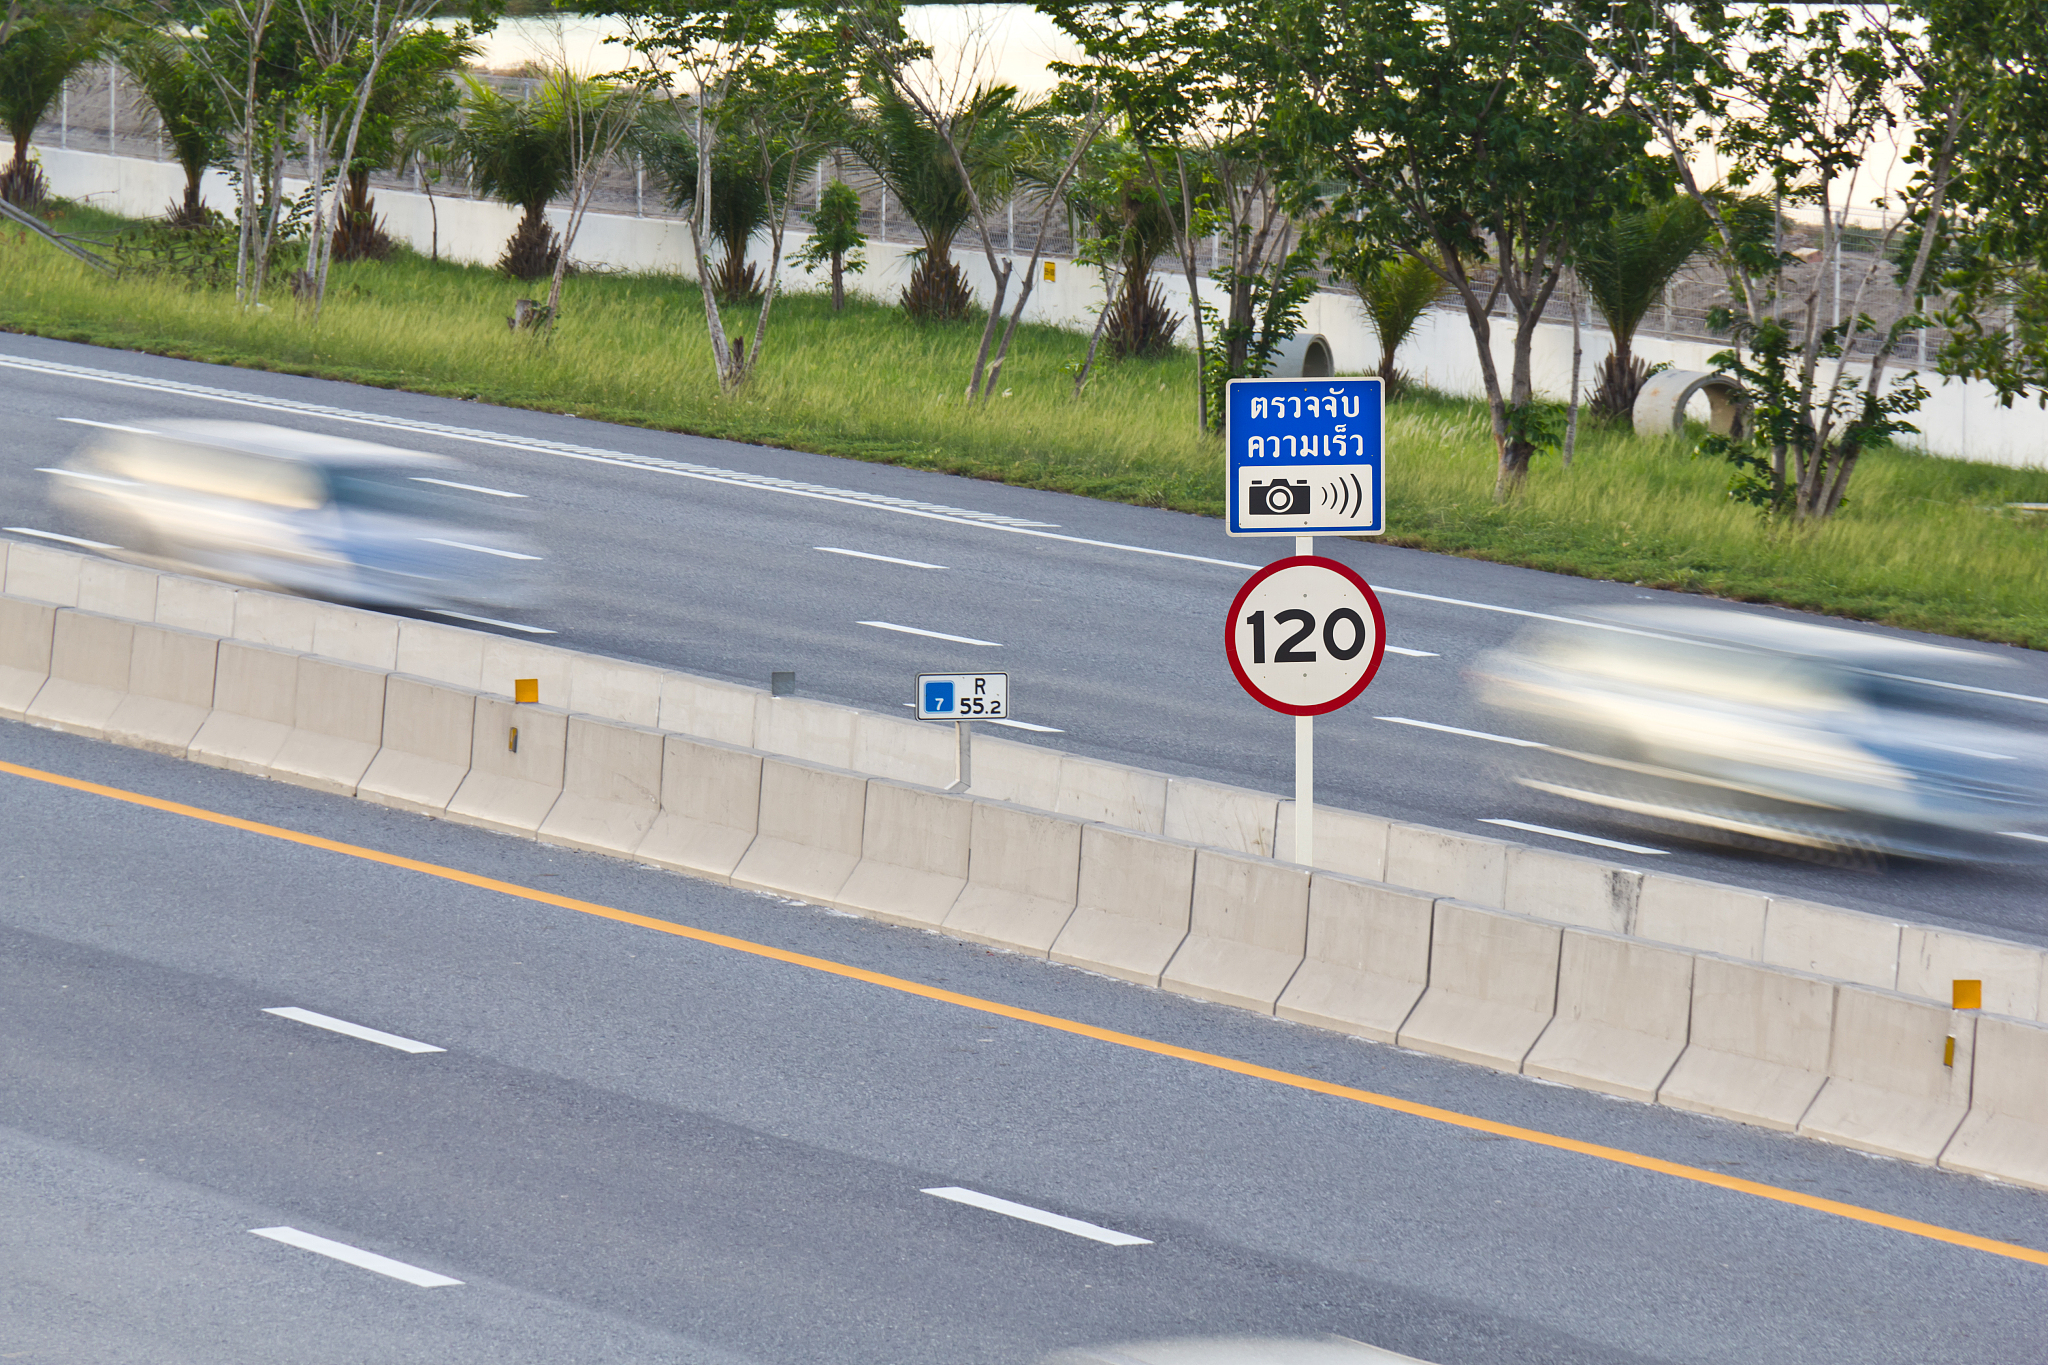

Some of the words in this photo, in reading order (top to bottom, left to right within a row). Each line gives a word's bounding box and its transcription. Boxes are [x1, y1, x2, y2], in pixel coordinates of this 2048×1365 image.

[1250, 387, 1360, 419] ตรวจจับ
[1247, 423, 1364, 458] ความเร็ว
[1246, 607, 1366, 664] 120
[974, 677, 986, 695] R
[934, 698, 944, 711] 7
[960, 697, 1001, 715] 55.2
